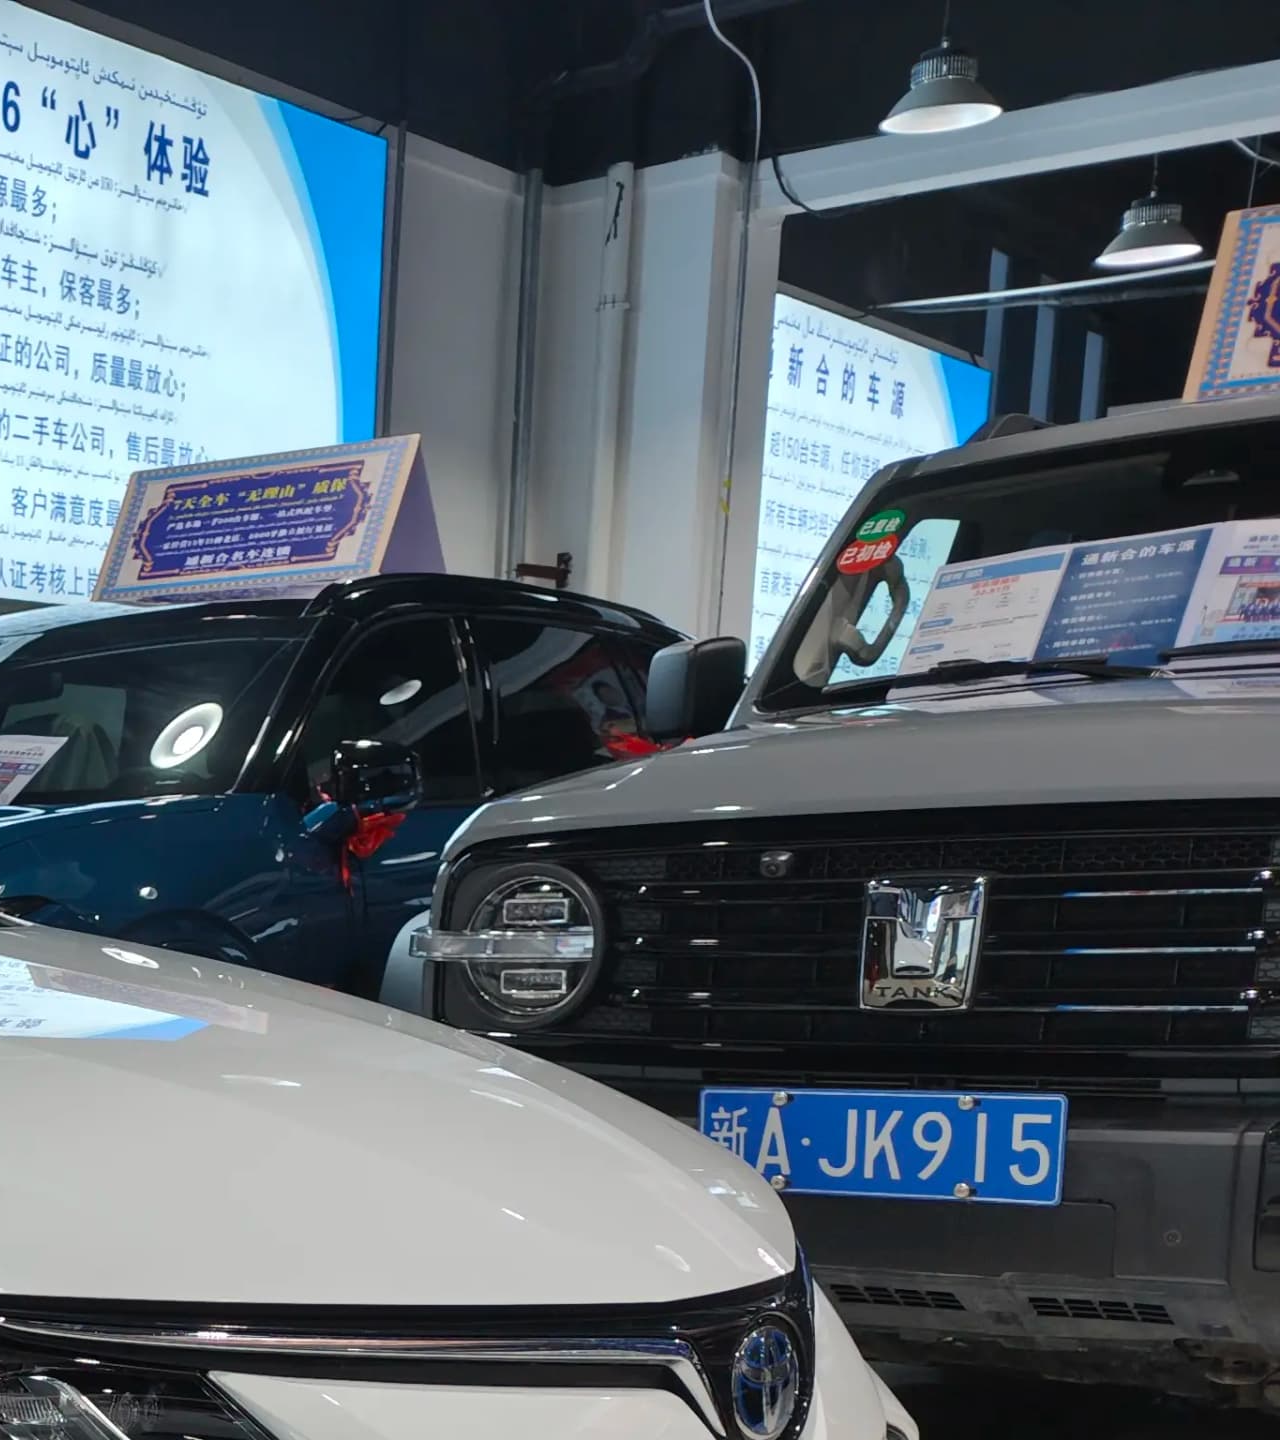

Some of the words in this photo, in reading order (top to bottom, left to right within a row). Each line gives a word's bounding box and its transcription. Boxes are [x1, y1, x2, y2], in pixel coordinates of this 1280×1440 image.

[768, 343, 907, 419] 新合的车源
[874, 985, 953, 999] TANK
